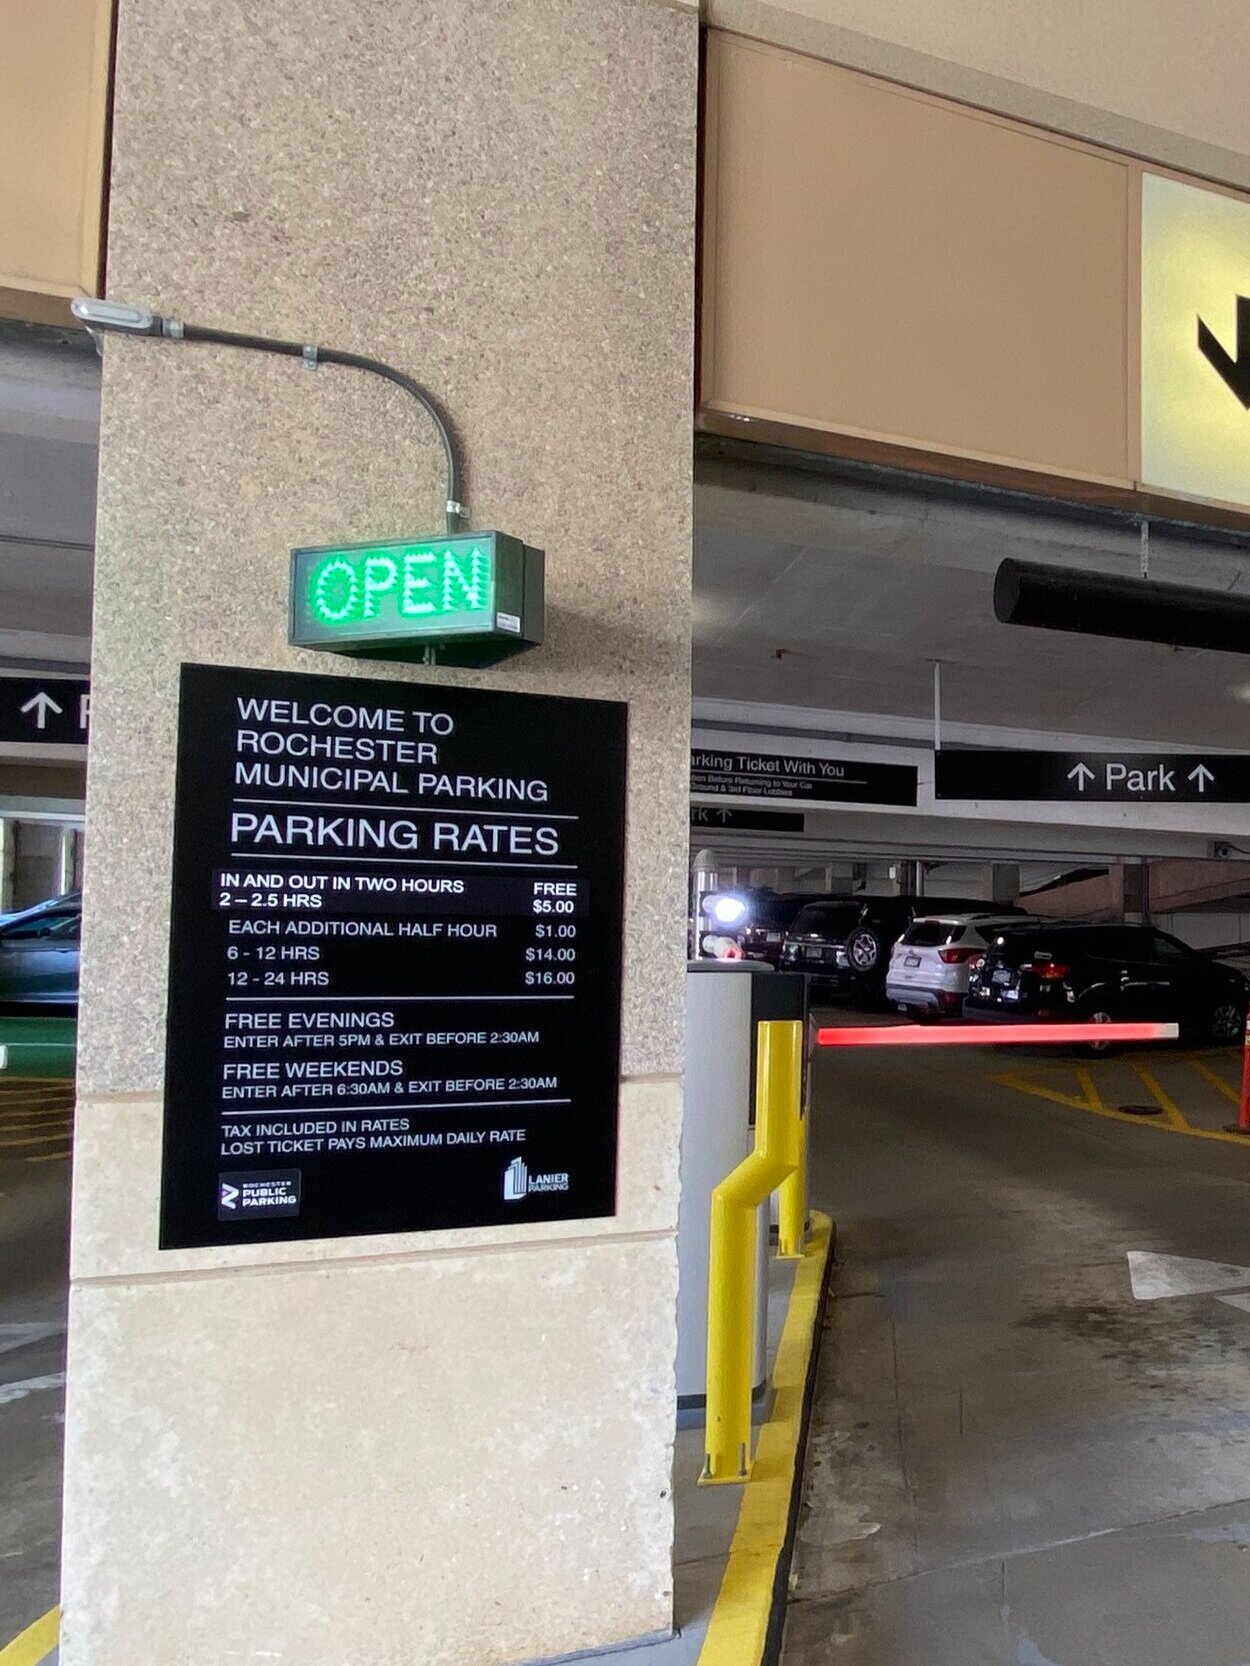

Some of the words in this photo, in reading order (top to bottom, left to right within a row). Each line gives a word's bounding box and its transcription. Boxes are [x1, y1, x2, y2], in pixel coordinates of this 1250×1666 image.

[313, 547, 485, 622] OPEN
[237, 698, 404, 731] WELCOME
[413, 712, 453, 735] TO
[238, 730, 437, 764] ROCHESTER
[737, 756, 780, 773] Ticket
[784, 761, 816, 775] With
[819, 763, 844, 777] You
[236, 762, 408, 793] MUNICIPAL
[419, 773, 547, 801] PARKING
[1106, 763, 1175, 791] Park
[232, 813, 417, 849] PARKING
[434, 823, 558, 855] RATES
[221, 873, 239, 887] IN
[243, 874, 284, 888] AND
[289, 875, 329, 889] OUT
[333, 877, 350, 890] IN
[355, 877, 397, 891] TWO
[402, 879, 464, 893] HOURS
[534, 882, 577, 896] FREE
[219, 892, 231, 906] 2
[251, 893, 278, 907] 2.5
[283, 894, 322, 908] HRS
[533, 899, 574, 914] $5.00
[229, 920, 279, 934] EACH
[285, 921, 393, 936] ADDITIONAL
[399, 923, 443, 936] HALF
[448, 924, 496, 937] HOUR
[536, 924, 576, 937] $1.00
[228, 946, 238, 959] 6
[257, 947, 275, 959] 12
[281, 946, 319, 960] HRS
[526, 948, 575, 961] $14.00
[228, 972, 247, 985] 12
[264, 972, 285, 985] 24
[291, 972, 329, 985] HRS
[525, 971, 574, 984] $16.00
[226, 1013, 281, 1029] FREE
[289, 1012, 394, 1028] EVENINGS
[224, 1036, 278, 1048] ENTER
[283, 1035, 334, 1047] AFTER
[339, 1034, 370, 1046] 5PM
[375, 1034, 384, 1045] &
[390, 1033, 423, 1045] EXIT
[427, 1032, 486, 1044] BEFORE
[491, 1032, 539, 1043] 2:30AM
[224, 1063, 280, 1079] FREE
[285, 1060, 403, 1078] WEEKENDS
[222, 1086, 276, 1098] ENTER
[281, 1084, 333, 1096] AFTER
[337, 1082, 390, 1095] 6:30AM
[394, 1082, 403, 1093] &
[409, 1081, 442, 1093] EXIT
[446, 1079, 505, 1091] BEFORE
[509, 1077, 557, 1089] 2:30AM
[221, 1125, 251, 1137] TAX
[257, 1122, 337, 1136] INCLUDED
[342, 1121, 356, 1132] IN
[361, 1119, 409, 1131] RATES
[221, 1142, 264, 1155] LOST
[267, 1139, 324, 1152] TICKET
[329, 1137, 365, 1150] PAYS
[370, 1134, 442, 1148] MAXIMUM
[447, 1132, 485, 1144] DAILY
[490, 1129, 525, 1142] RATE
[528, 1173, 569, 1185] LANIER
[528, 1183, 569, 1193] PARKING
[242, 1187, 287, 1198] PUBLIC
[242, 1195, 297, 1208] PARKING
